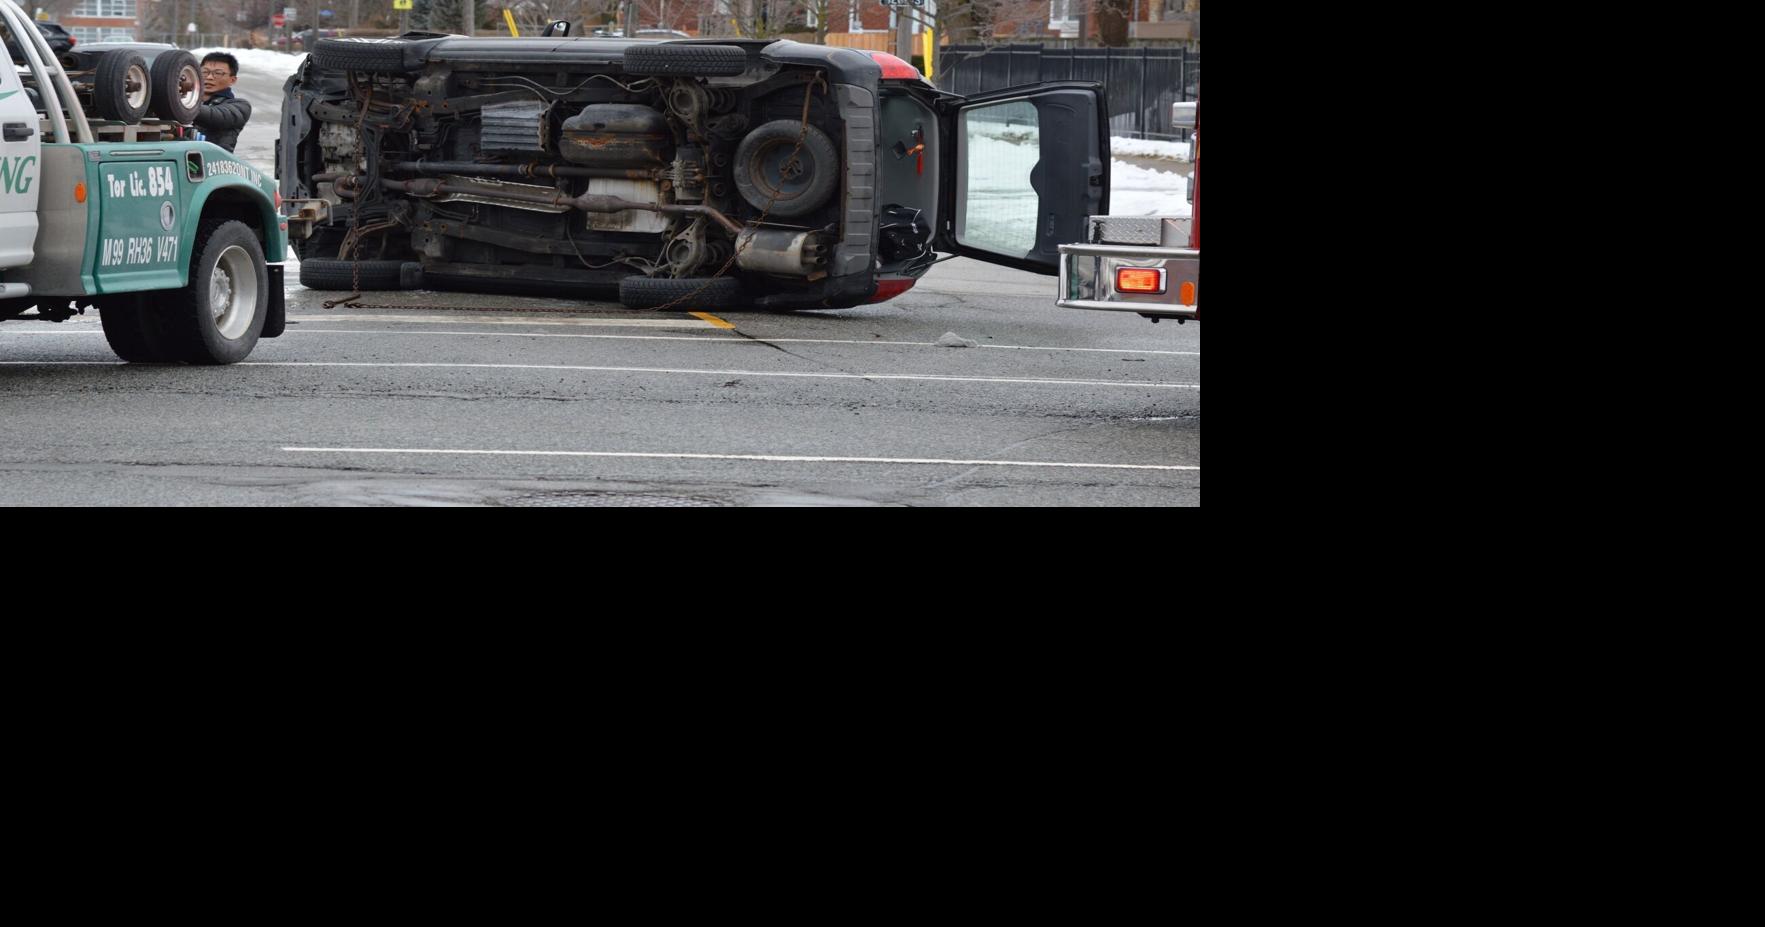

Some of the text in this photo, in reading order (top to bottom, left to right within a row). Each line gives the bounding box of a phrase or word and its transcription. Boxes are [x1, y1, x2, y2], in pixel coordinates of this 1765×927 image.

[107, 166, 174, 198] Tor Lic. 854
[250, 169, 262, 188] INC
[126, 237, 153, 264] RH36
[157, 236, 178, 262] V471
